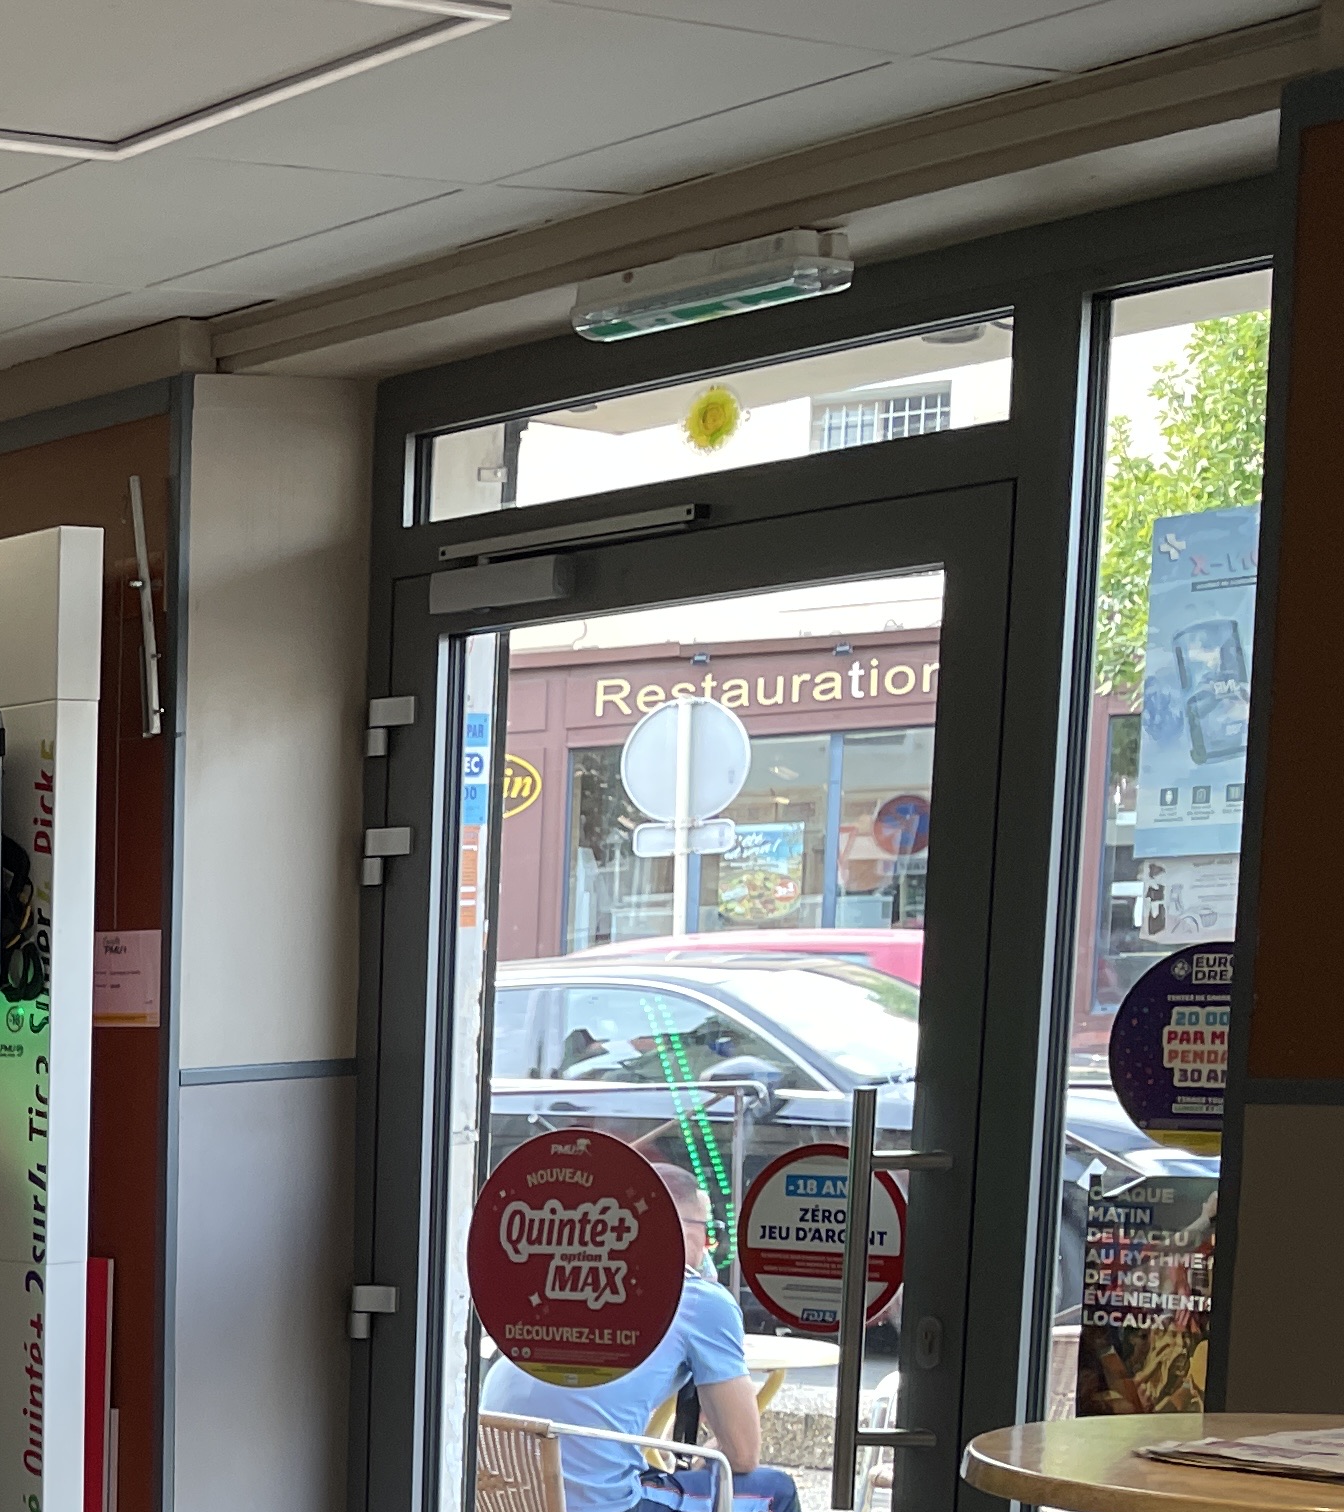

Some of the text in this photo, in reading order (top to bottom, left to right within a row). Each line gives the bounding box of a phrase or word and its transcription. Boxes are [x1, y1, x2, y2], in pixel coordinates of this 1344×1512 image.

[1194, 969, 1233, 982] DRE
[1175, 1011, 1200, 1026] 20
[1167, 1030, 1205, 1045] PAR
[1177, 1068, 1202, 1082] 30
[551, 1144, 575, 1156] PMU
[526, 1167, 594, 1188] NOUVEAU
[787, 1179, 818, 1194] -18
[799, 1204, 847, 1224] ZÉRO
[1088, 1205, 1150, 1223] MATIN
[506, 1205, 632, 1255] Quinté+
[759, 1225, 790, 1240] JEU
[1087, 1227, 1189, 1247] DE L'ACTU
[560, 1250, 603, 1263] option
[1085, 1248, 1206, 1269] AU RYTHME
[551, 1264, 621, 1302] MAX
[1085, 1269, 1160, 1287] DE NOS
[1083, 1310, 1165, 1330] LOCAUX
[505, 1321, 613, 1344] DÉCOUVREZ-LE
